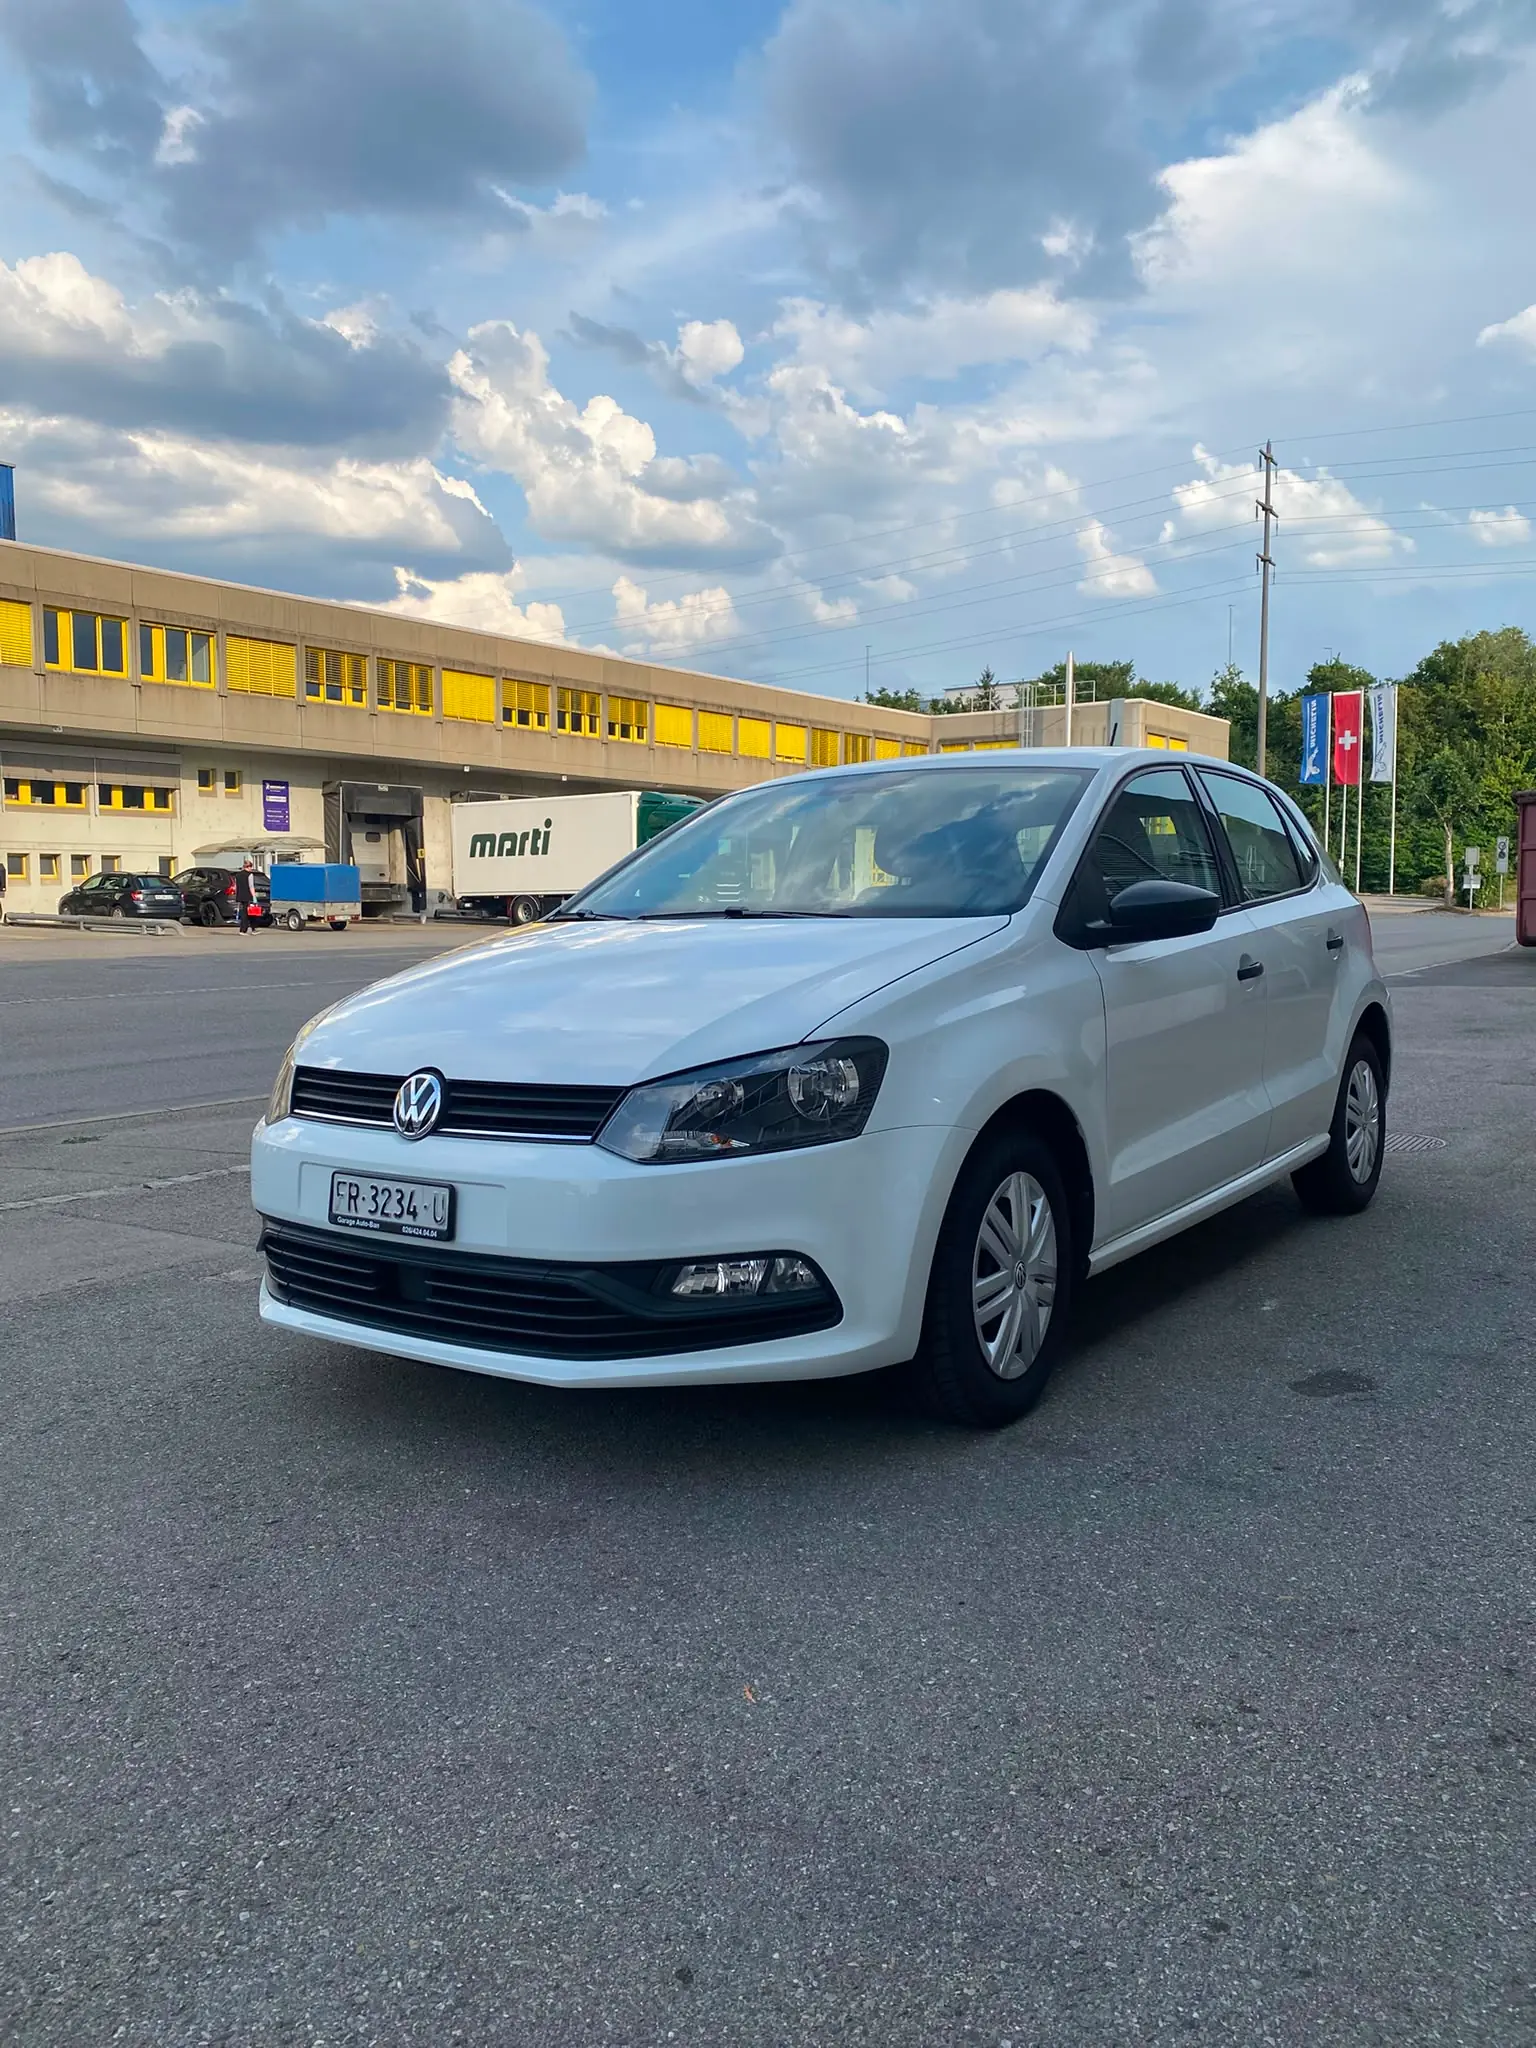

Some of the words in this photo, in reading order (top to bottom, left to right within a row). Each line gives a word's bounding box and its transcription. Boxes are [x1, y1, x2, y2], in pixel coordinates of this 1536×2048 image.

[469, 817, 552, 858] marti
[336, 1216, 356, 1227] Garage
[356, 1218, 380, 1229] Auto-Ban
